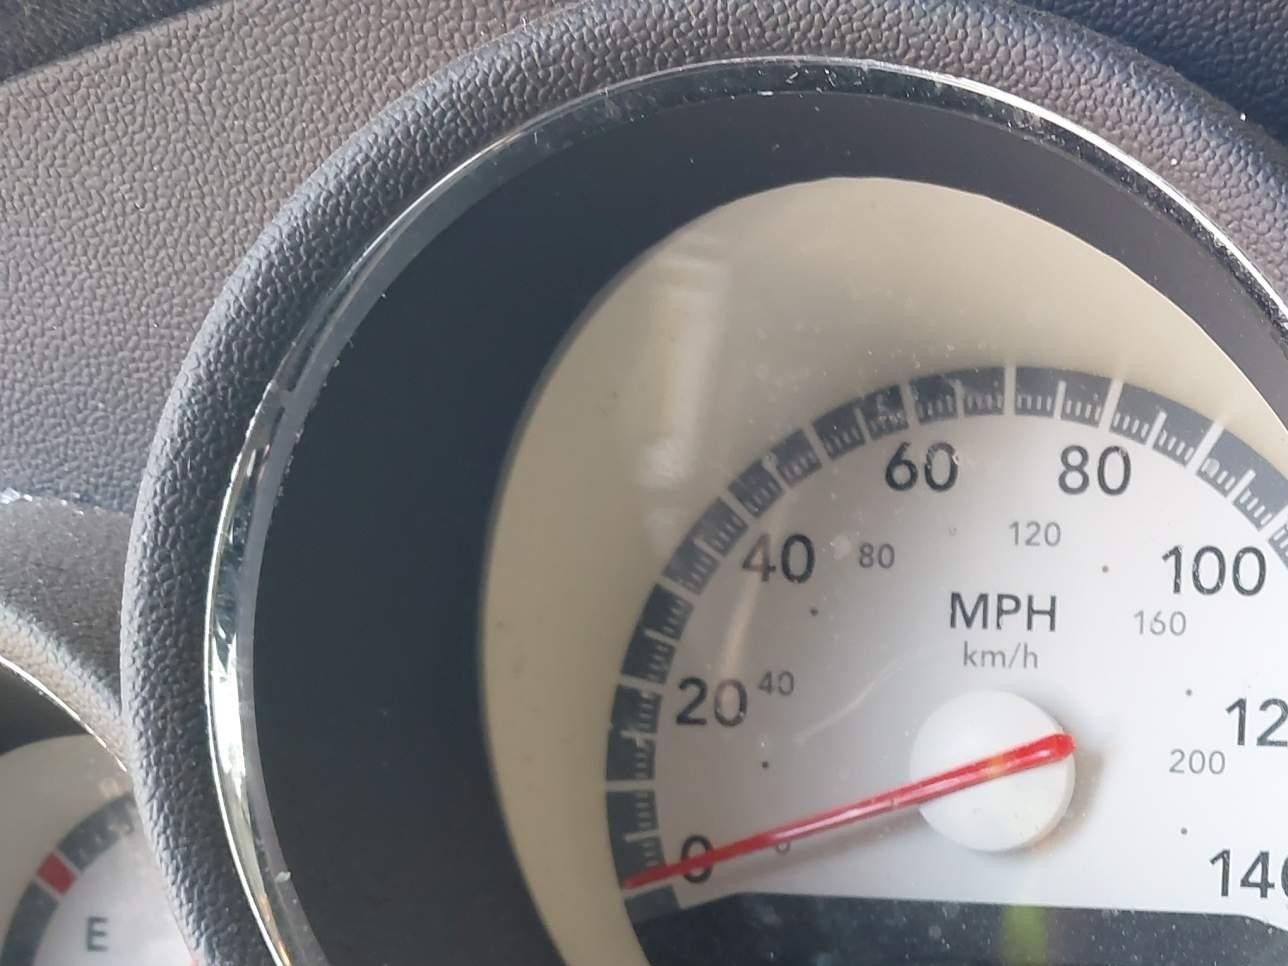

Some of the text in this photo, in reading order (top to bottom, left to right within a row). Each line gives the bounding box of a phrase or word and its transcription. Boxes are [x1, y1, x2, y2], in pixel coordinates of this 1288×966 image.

[885, 442, 959, 492] 60
[1057, 444, 1132, 496] 80
[1008, 521, 1062, 547] 120
[742, 533, 816, 583] 40
[858, 543, 895, 569] 80
[1161, 545, 1267, 596] 100
[949, 592, 1057, 632] MPH
[1133, 610, 1187, 637] 160
[962, 642, 1039, 670] km/h
[758, 671, 796, 697] 40
[675, 679, 748, 727] 20
[1169, 749, 1226, 776] 200
[681, 836, 714, 884] 0
[86, 917, 108, 952] E
